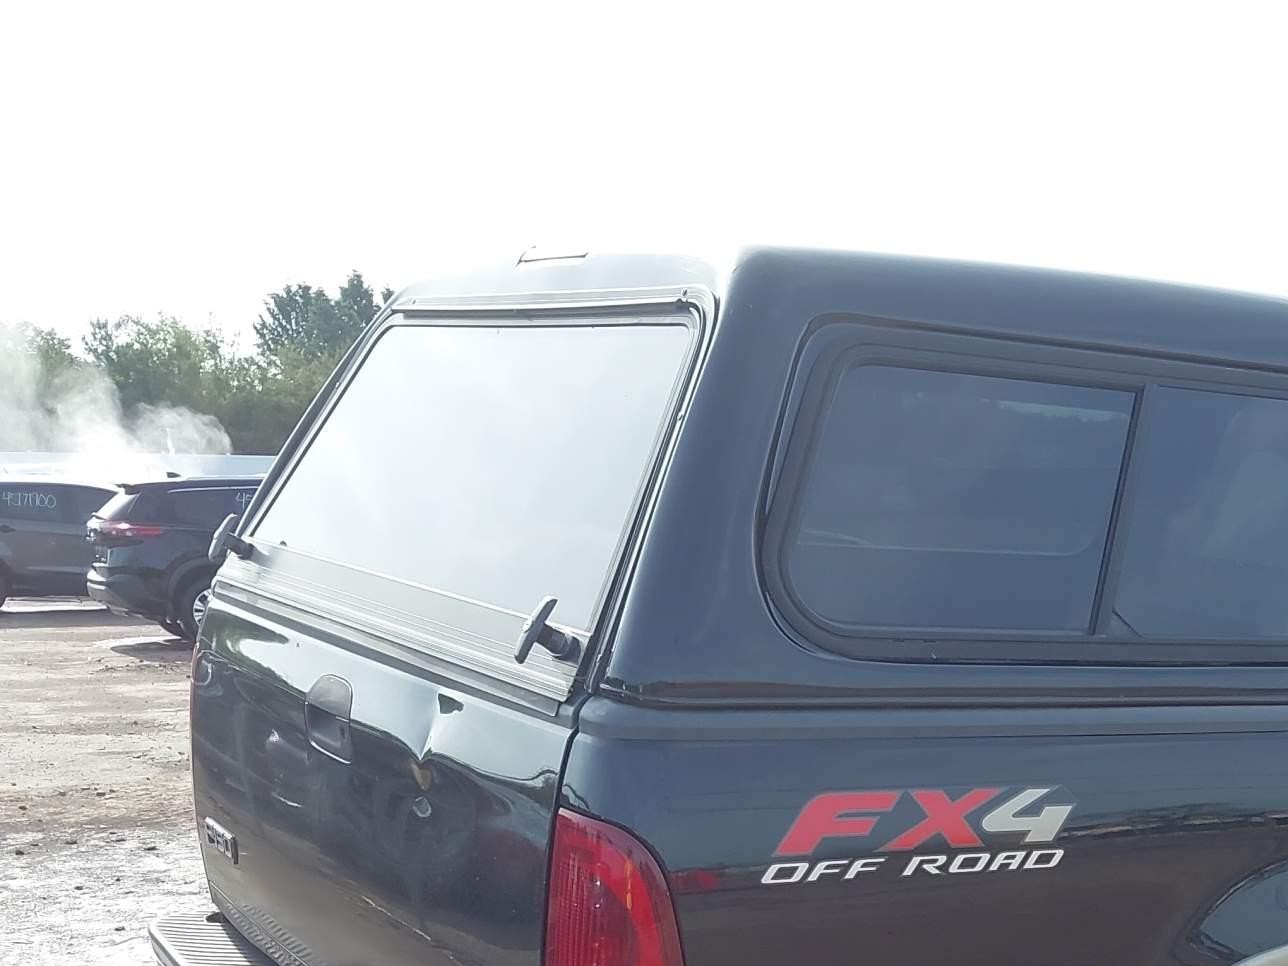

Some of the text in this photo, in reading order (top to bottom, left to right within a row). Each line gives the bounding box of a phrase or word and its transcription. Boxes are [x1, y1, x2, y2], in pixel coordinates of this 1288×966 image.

[772, 787, 1073, 856] FX4
[760, 849, 1065, 884] OFF ROAD
